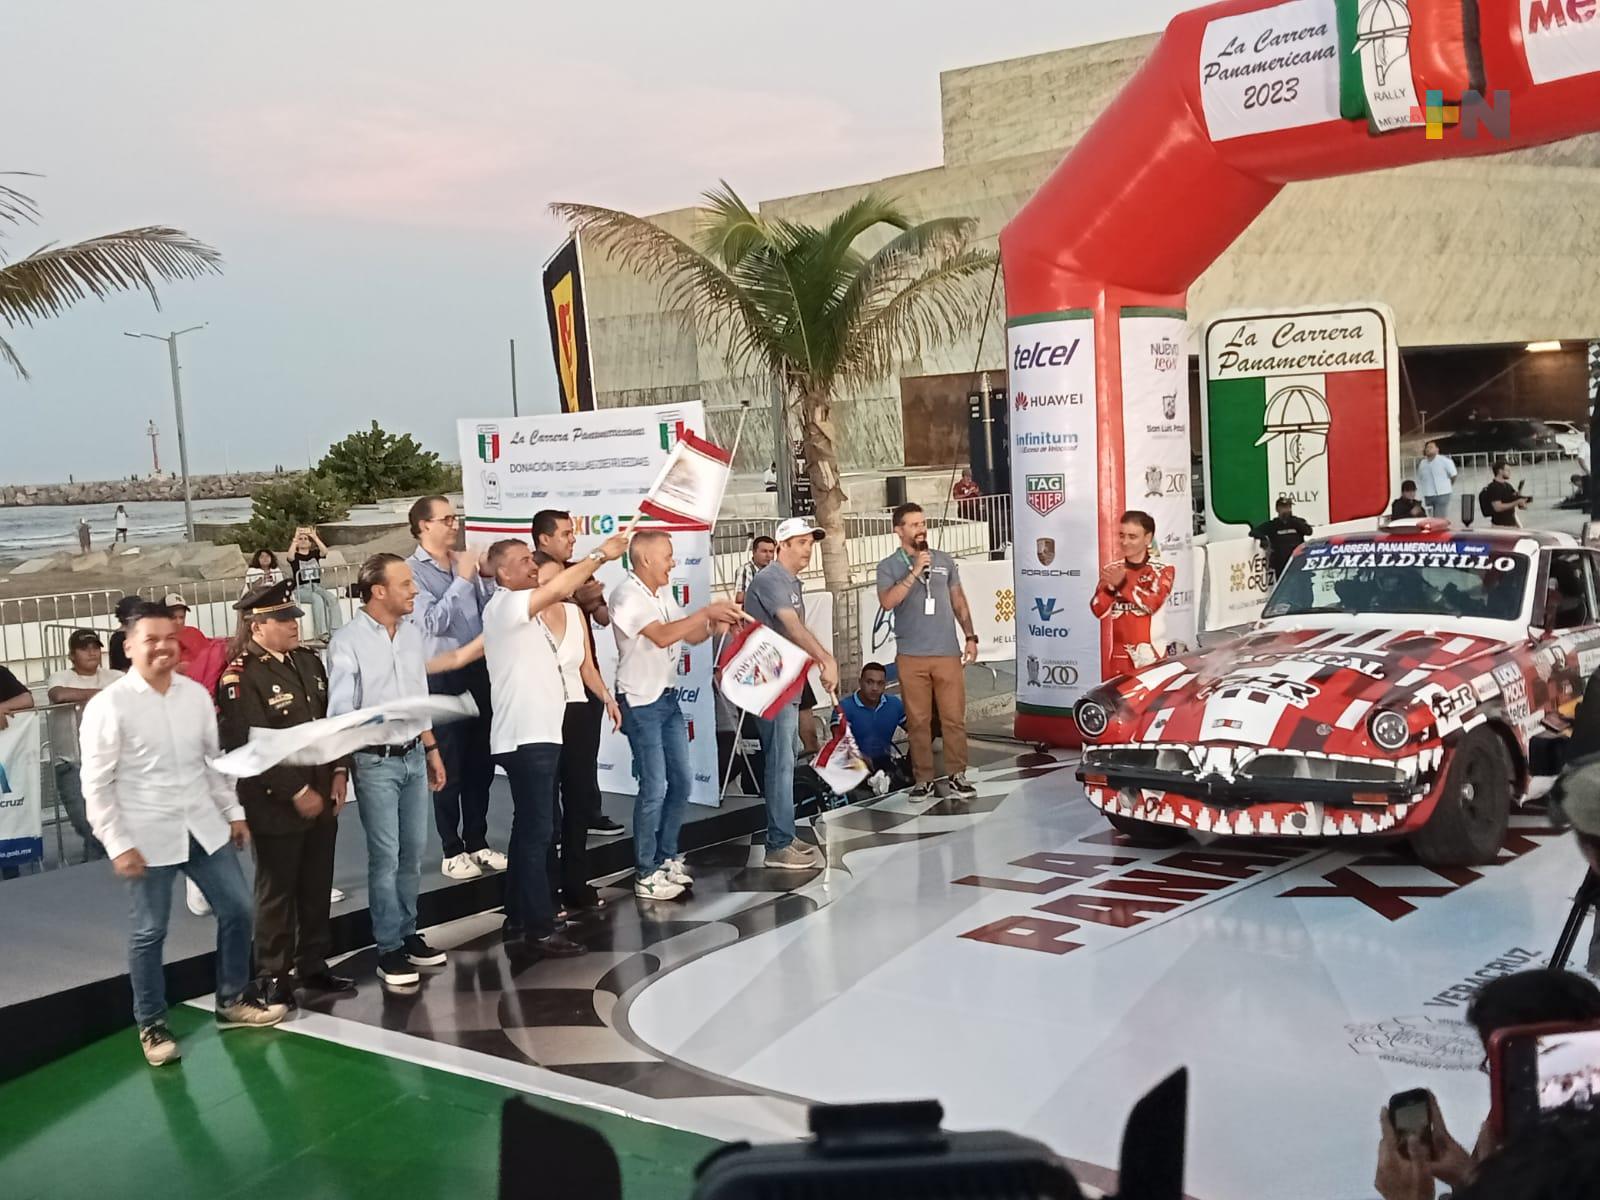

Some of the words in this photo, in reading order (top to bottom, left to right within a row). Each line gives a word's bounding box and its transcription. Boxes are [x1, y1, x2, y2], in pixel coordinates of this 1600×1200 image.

[1218, 35, 1246, 60] La
[1254, 22, 1328, 54] Carrera
[1203, 44, 1337, 84] Panamericana
[1243, 77, 1300, 111] 2023
[1373, 87, 1408, 102] RALLY
[1225, 325, 1258, 349] La
[1272, 321, 1364, 349] Carrera
[1014, 338, 1081, 371] telcel
[1218, 349, 1376, 376] Panamericana
[1030, 393, 1084, 407] HUAWEI
[510, 431, 525, 444] La
[530, 429, 569, 445] Carrera
[1016, 430, 1079, 446] infinitum
[1028, 477, 1061, 491] TAG
[1028, 493, 1062, 512] HEUER
[1278, 490, 1320, 504] RALLY
[1330, 543, 1377, 555] CARRERA
[1377, 542, 1458, 554] PANAMERICANA
[1339, 551, 1516, 572] MALDITILLO
[1021, 568, 1081, 577] PORSCHE
[1247, 572, 1274, 593] CRUZ
[1028, 624, 1069, 638] Valero
[1041, 665, 1079, 686] 200
